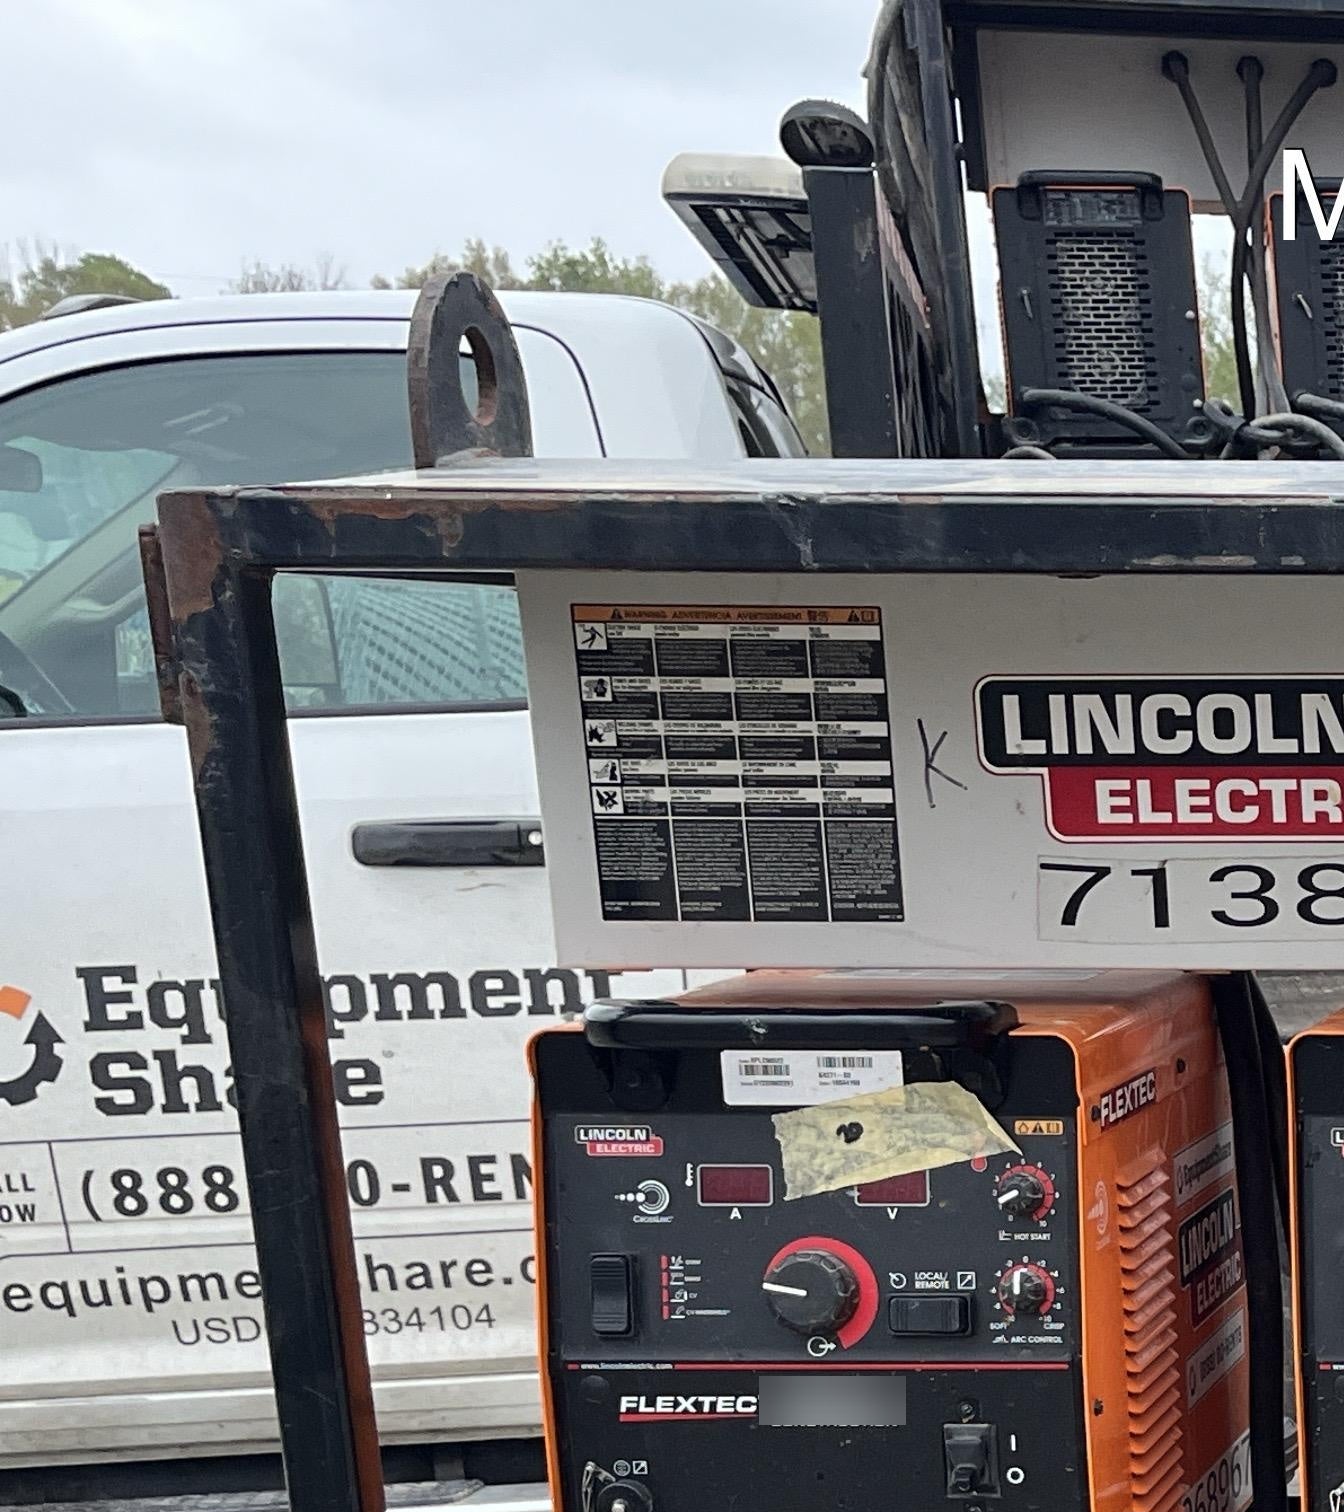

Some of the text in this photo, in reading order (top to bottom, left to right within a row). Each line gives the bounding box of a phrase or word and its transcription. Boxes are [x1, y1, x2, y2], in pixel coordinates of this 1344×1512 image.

[90, 1050, 385, 1117] She
[1100, 1072, 1156, 1127] FLEXTEC
[580, 1129, 646, 1140] LINCOLN
[596, 1144, 655, 1153] ELECTRIC
[730, 1208, 741, 1220] A
[887, 1207, 897, 1220] V
[1182, 1199, 1233, 1277] LINCOLN
[915, 1272, 948, 1280] LOCAL/
[915, 1281, 949, 1289] REMOTE
[620, 1396, 757, 1413] FLEXTEC
